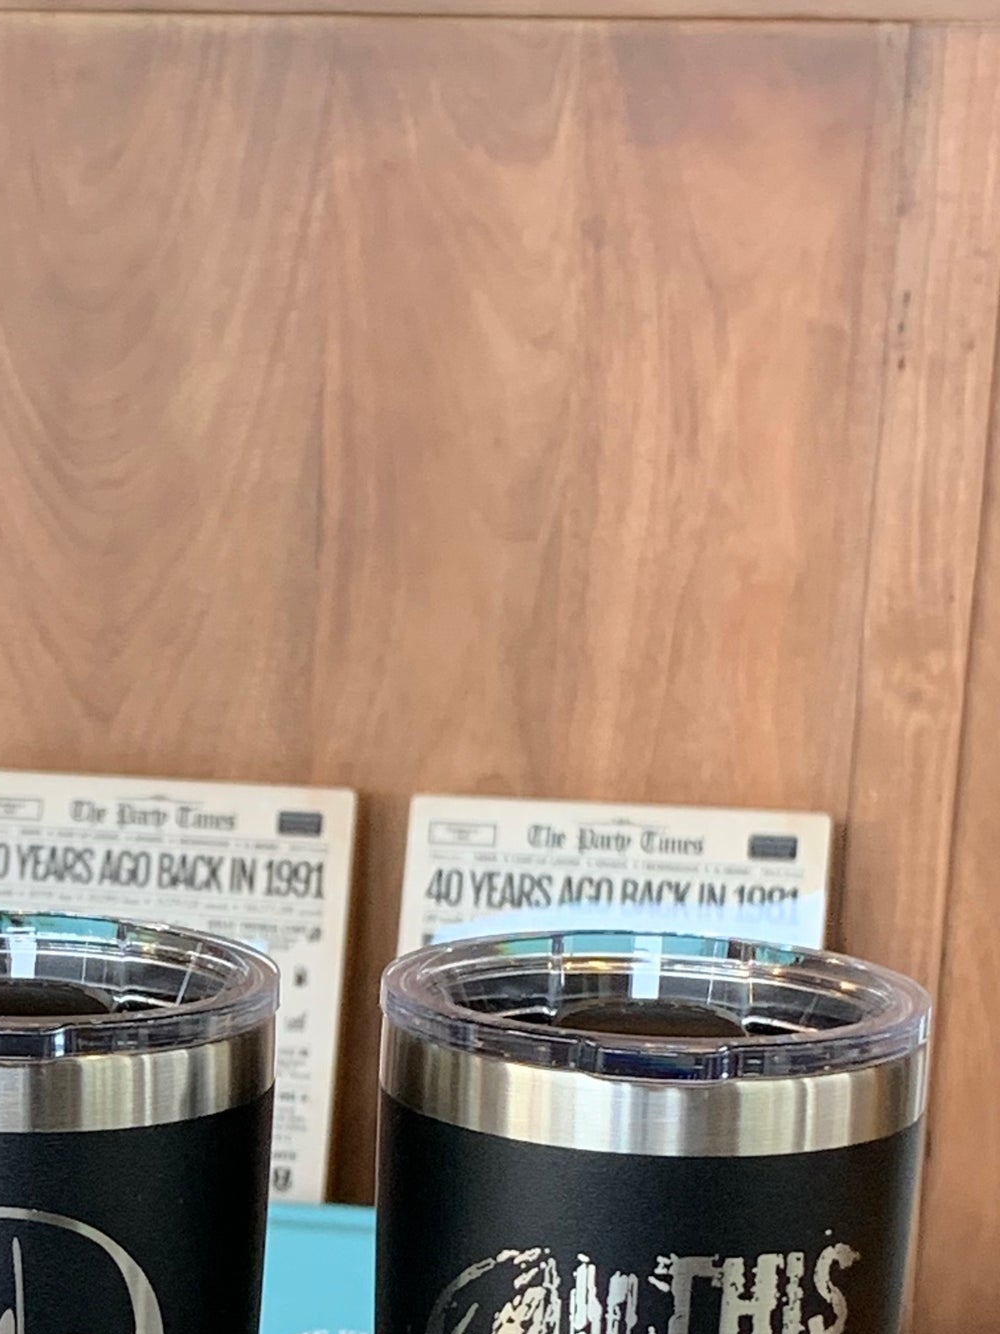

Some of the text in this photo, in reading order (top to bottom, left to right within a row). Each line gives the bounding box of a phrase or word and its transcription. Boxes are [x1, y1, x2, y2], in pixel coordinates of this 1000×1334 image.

[70, 799, 238, 831] The Party Times
[528, 824, 705, 855] The Party Times
[17, 844, 94, 885] YEARS
[99, 849, 151, 888] AGO
[157, 853, 224, 894] BACK
[229, 857, 257, 894] IN
[263, 858, 324, 899] 1991
[425, 868, 464, 908] 40
[470, 870, 553, 911] YEARS
[698, 882, 727, 914] IN
